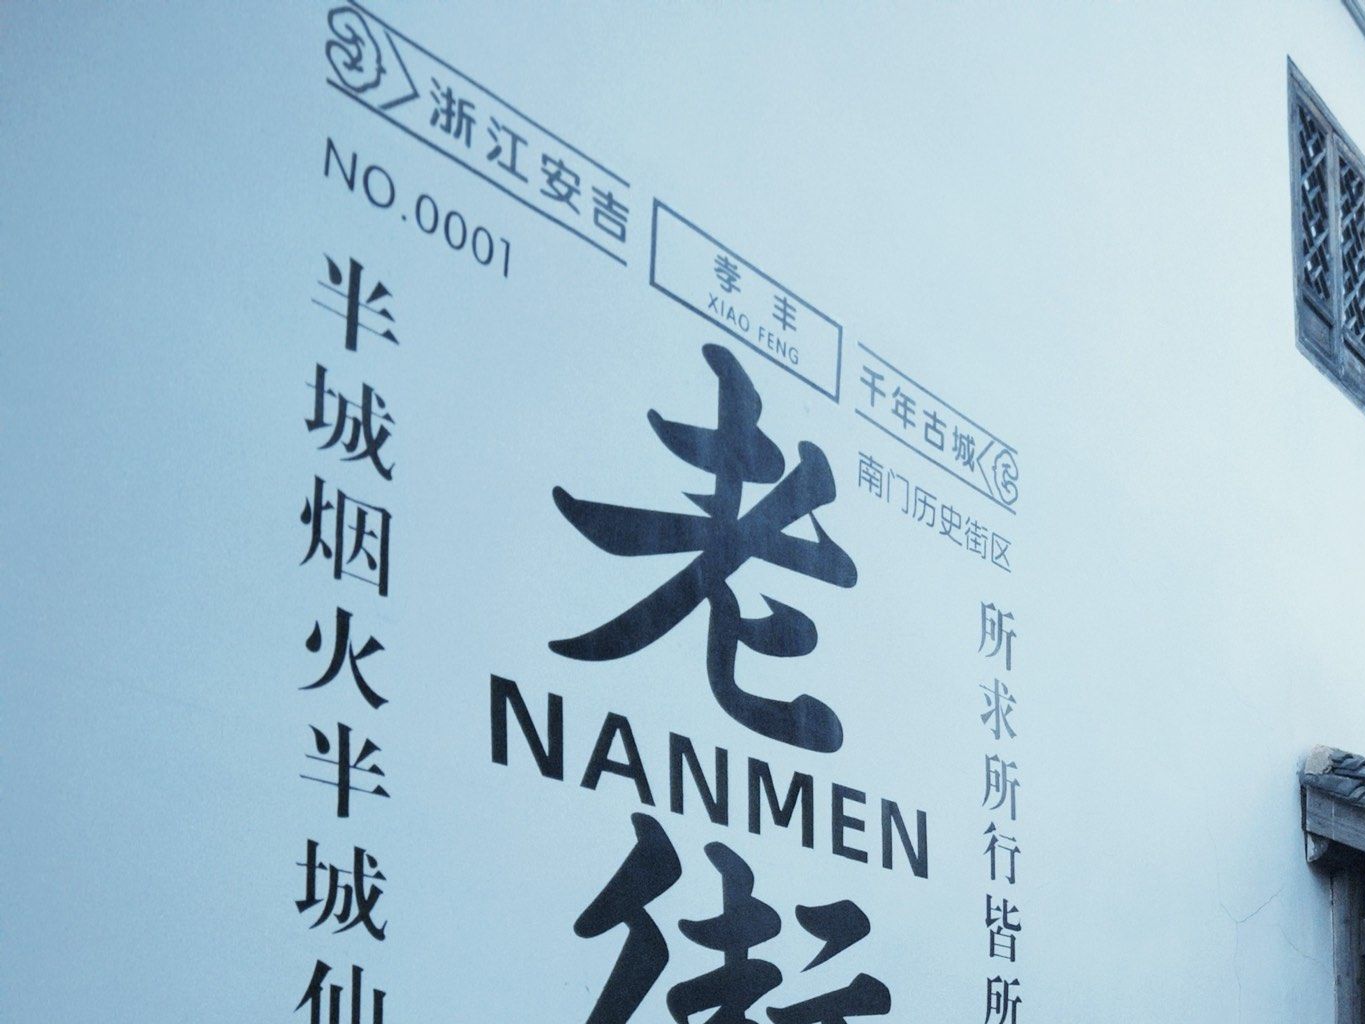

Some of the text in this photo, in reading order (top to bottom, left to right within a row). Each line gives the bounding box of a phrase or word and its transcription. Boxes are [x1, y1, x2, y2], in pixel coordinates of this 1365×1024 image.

[324, 136, 511, 278] NO.0001
[429, 77, 629, 243] 浙江安吉
[708, 292, 799, 365] XIAO FENG
[714, 254, 797, 332] 孝丰
[860, 365, 976, 472] 千年古城
[548, 343, 857, 753] 老
[858, 452, 1012, 573] 南门历史街区
[490, 674, 929, 879] NANMEN
